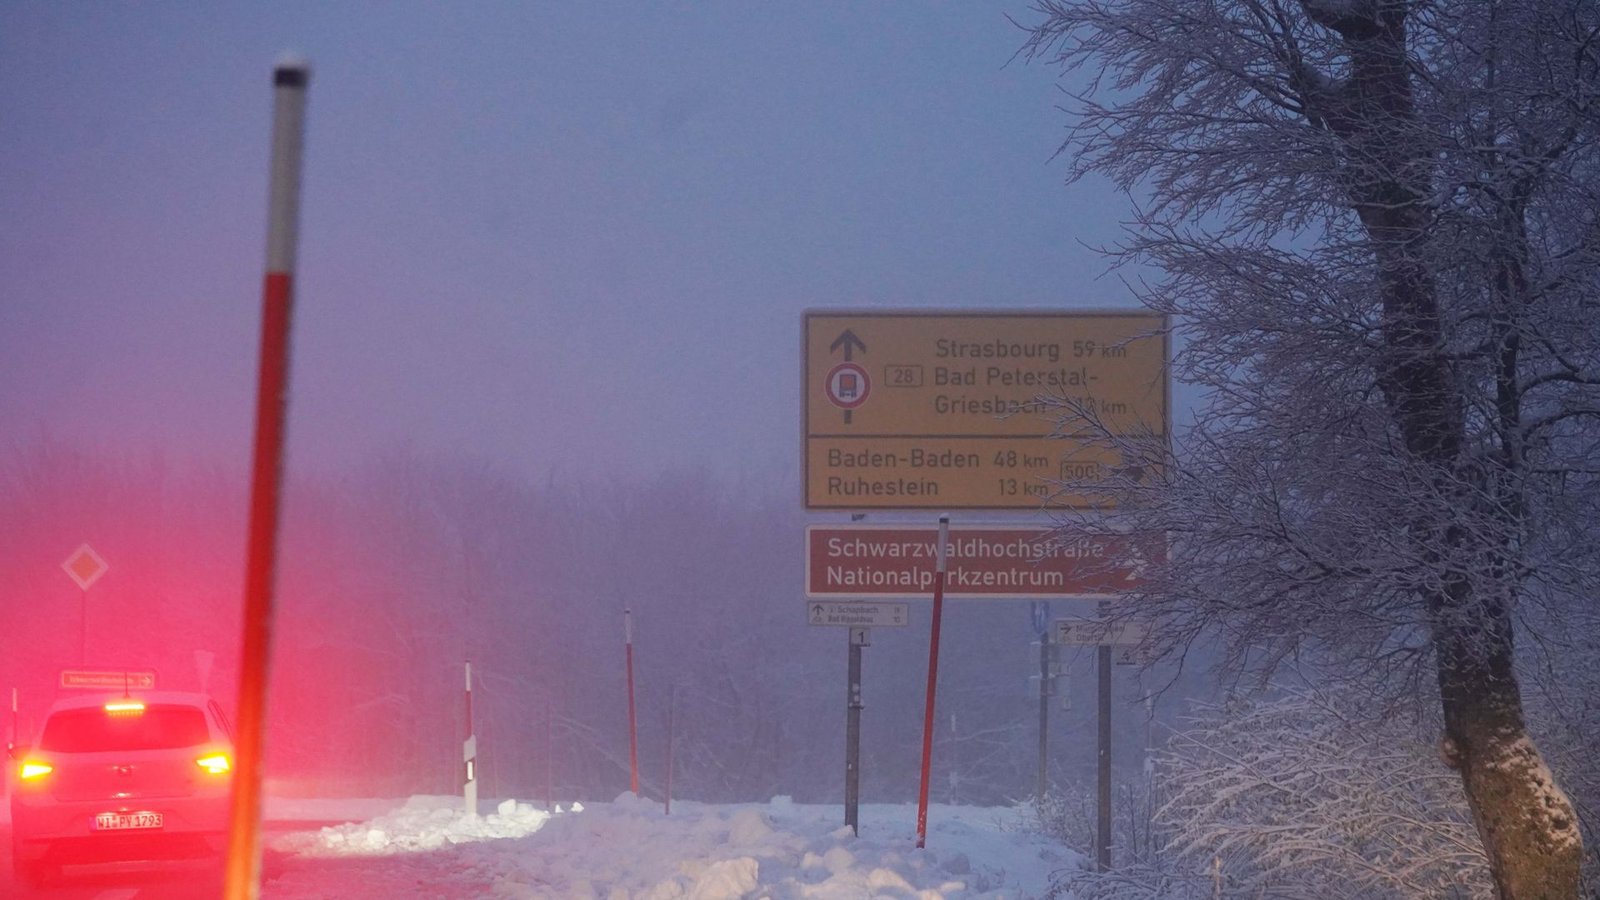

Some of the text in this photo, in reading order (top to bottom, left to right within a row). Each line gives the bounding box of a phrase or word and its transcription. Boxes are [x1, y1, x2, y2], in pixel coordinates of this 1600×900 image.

[935, 338, 1127, 362] Strasbourg 59 km
[894, 369, 913, 384] 28
[935, 367, 1099, 386] Bad Peterstal-
[935, 395, 1046, 414] Griesbach
[1101, 399, 1127, 414] km
[828, 449, 1049, 468] Baden-Baden 48 km
[828, 477, 1049, 496] Ruhestein 13 km
[827, 565, 1064, 590] Nationalprkzentrum
[857, 631, 865, 643] 1
[119, 815, 133, 828] PY
[134, 814, 161, 827] 1793
